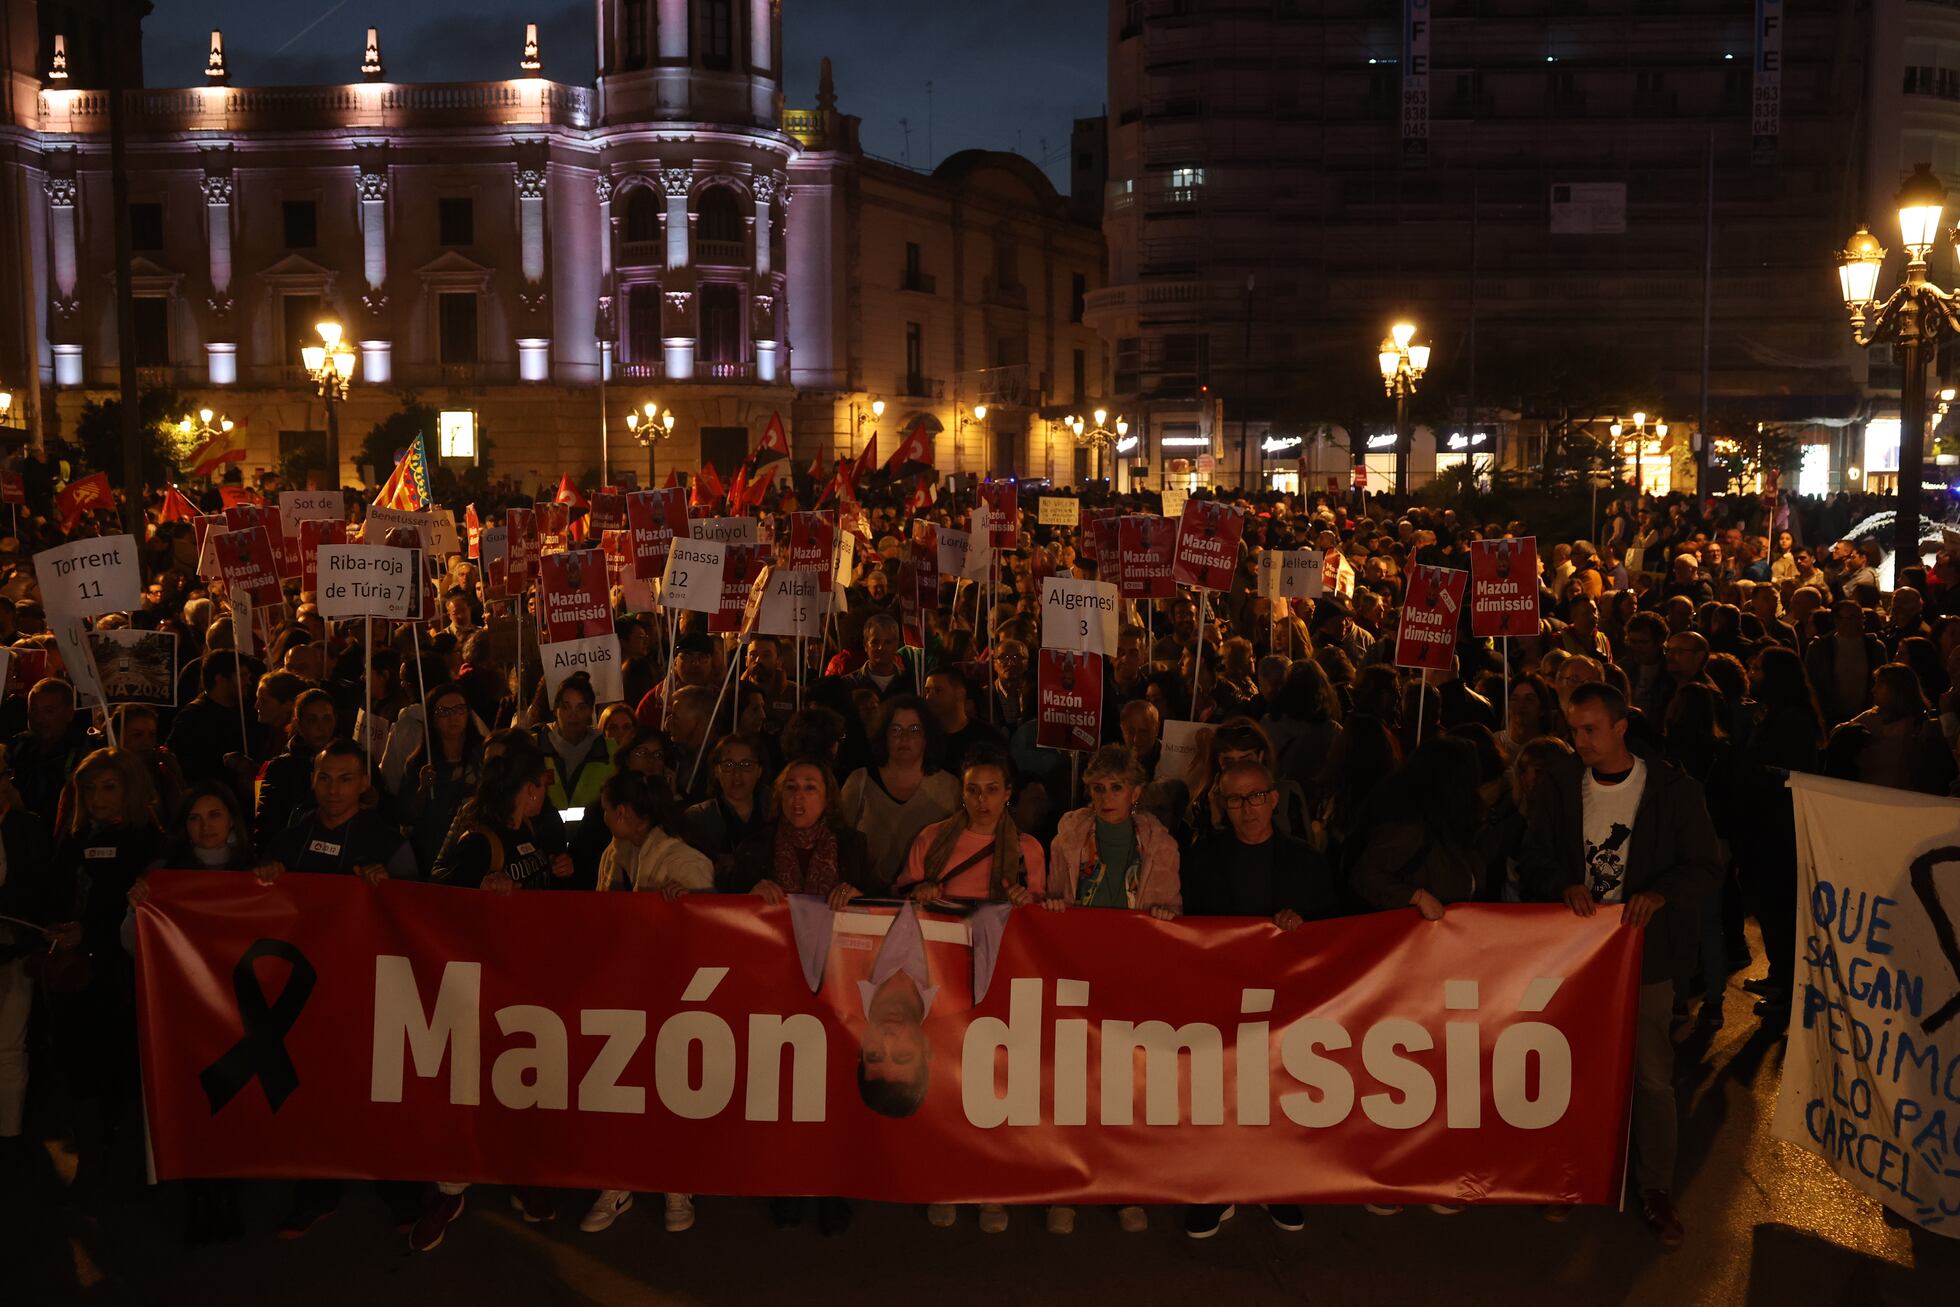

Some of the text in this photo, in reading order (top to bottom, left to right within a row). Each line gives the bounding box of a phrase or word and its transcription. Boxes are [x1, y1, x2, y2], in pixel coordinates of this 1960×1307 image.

[1404, 90, 1427, 104] 963
[1755, 87, 1778, 100] 963
[1754, 103, 1778, 117] 838
[1403, 123, 1426, 136] 045
[1753, 120, 1777, 133] 045
[294, 497, 333, 509] Sot de
[636, 526, 674, 543] Mazón
[693, 525, 748, 541] Bunyol
[1182, 532, 1222, 553] Mazón
[636, 542, 671, 557] dimis
[1123, 549, 1160, 564] Mazón
[51, 548, 122, 578] Torrent
[330, 554, 403, 576] Riba-roja
[1180, 549, 1232, 570] dimissió
[224, 563, 261, 579] Mazón
[670, 570, 688, 588] 12
[1124, 564, 1172, 578] dimissió
[77, 580, 104, 601] 11
[724, 579, 753, 594] azón
[1286, 575, 1294, 587] 4
[1476, 578, 1519, 596] Mazón
[325, 582, 405, 601] de Túria 7
[548, 588, 592, 607] Mazón
[1048, 588, 1115, 612] Algemesí
[1476, 594, 1534, 613] dimissió
[551, 604, 607, 624] dimissió
[1406, 605, 1443, 626] Mazón
[1079, 619, 1089, 636] 3
[1404, 624, 1452, 646] dimissió
[554, 646, 612, 668] Alaquàs
[1043, 688, 1083, 708] Mazón
[1043, 707, 1096, 728] dimissió
[1812, 880, 1899, 955] QUE
[370, 953, 1573, 1130] Mazón dimissió
[1833, 1062, 1872, 1120] LO
[1806, 1098, 1923, 1204] CARCEL
